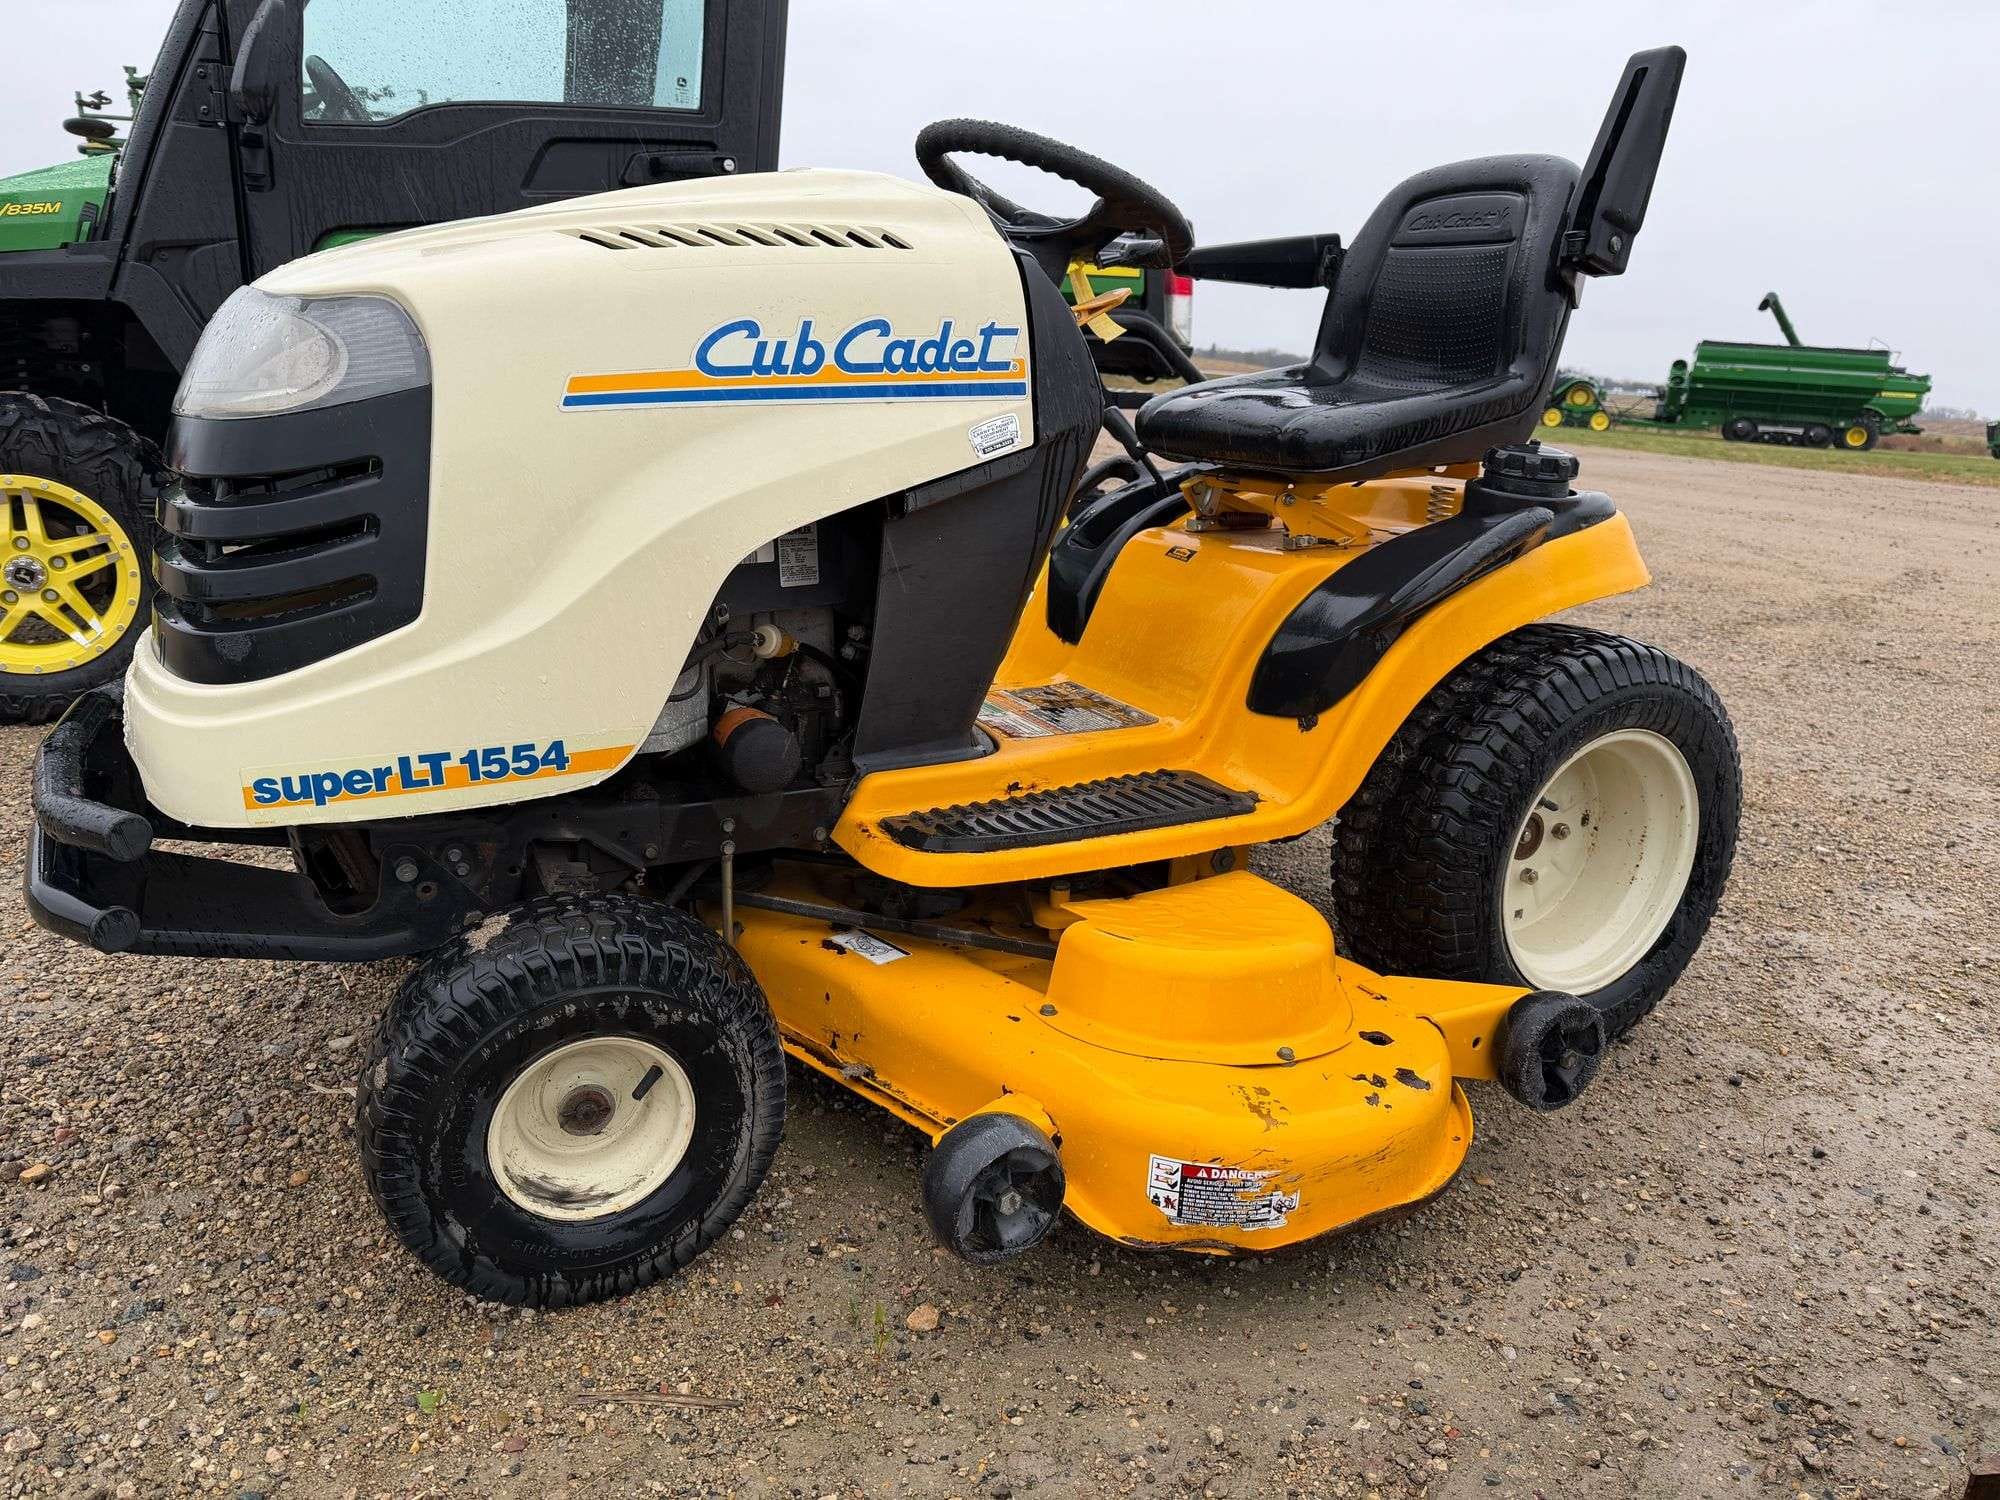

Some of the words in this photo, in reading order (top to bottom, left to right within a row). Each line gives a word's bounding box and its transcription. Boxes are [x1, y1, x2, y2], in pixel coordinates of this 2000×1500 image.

[695, 319, 826, 377] Cub
[459, 740, 570, 782] 1554
[1211, 1168, 1264, 1182] DANGER
